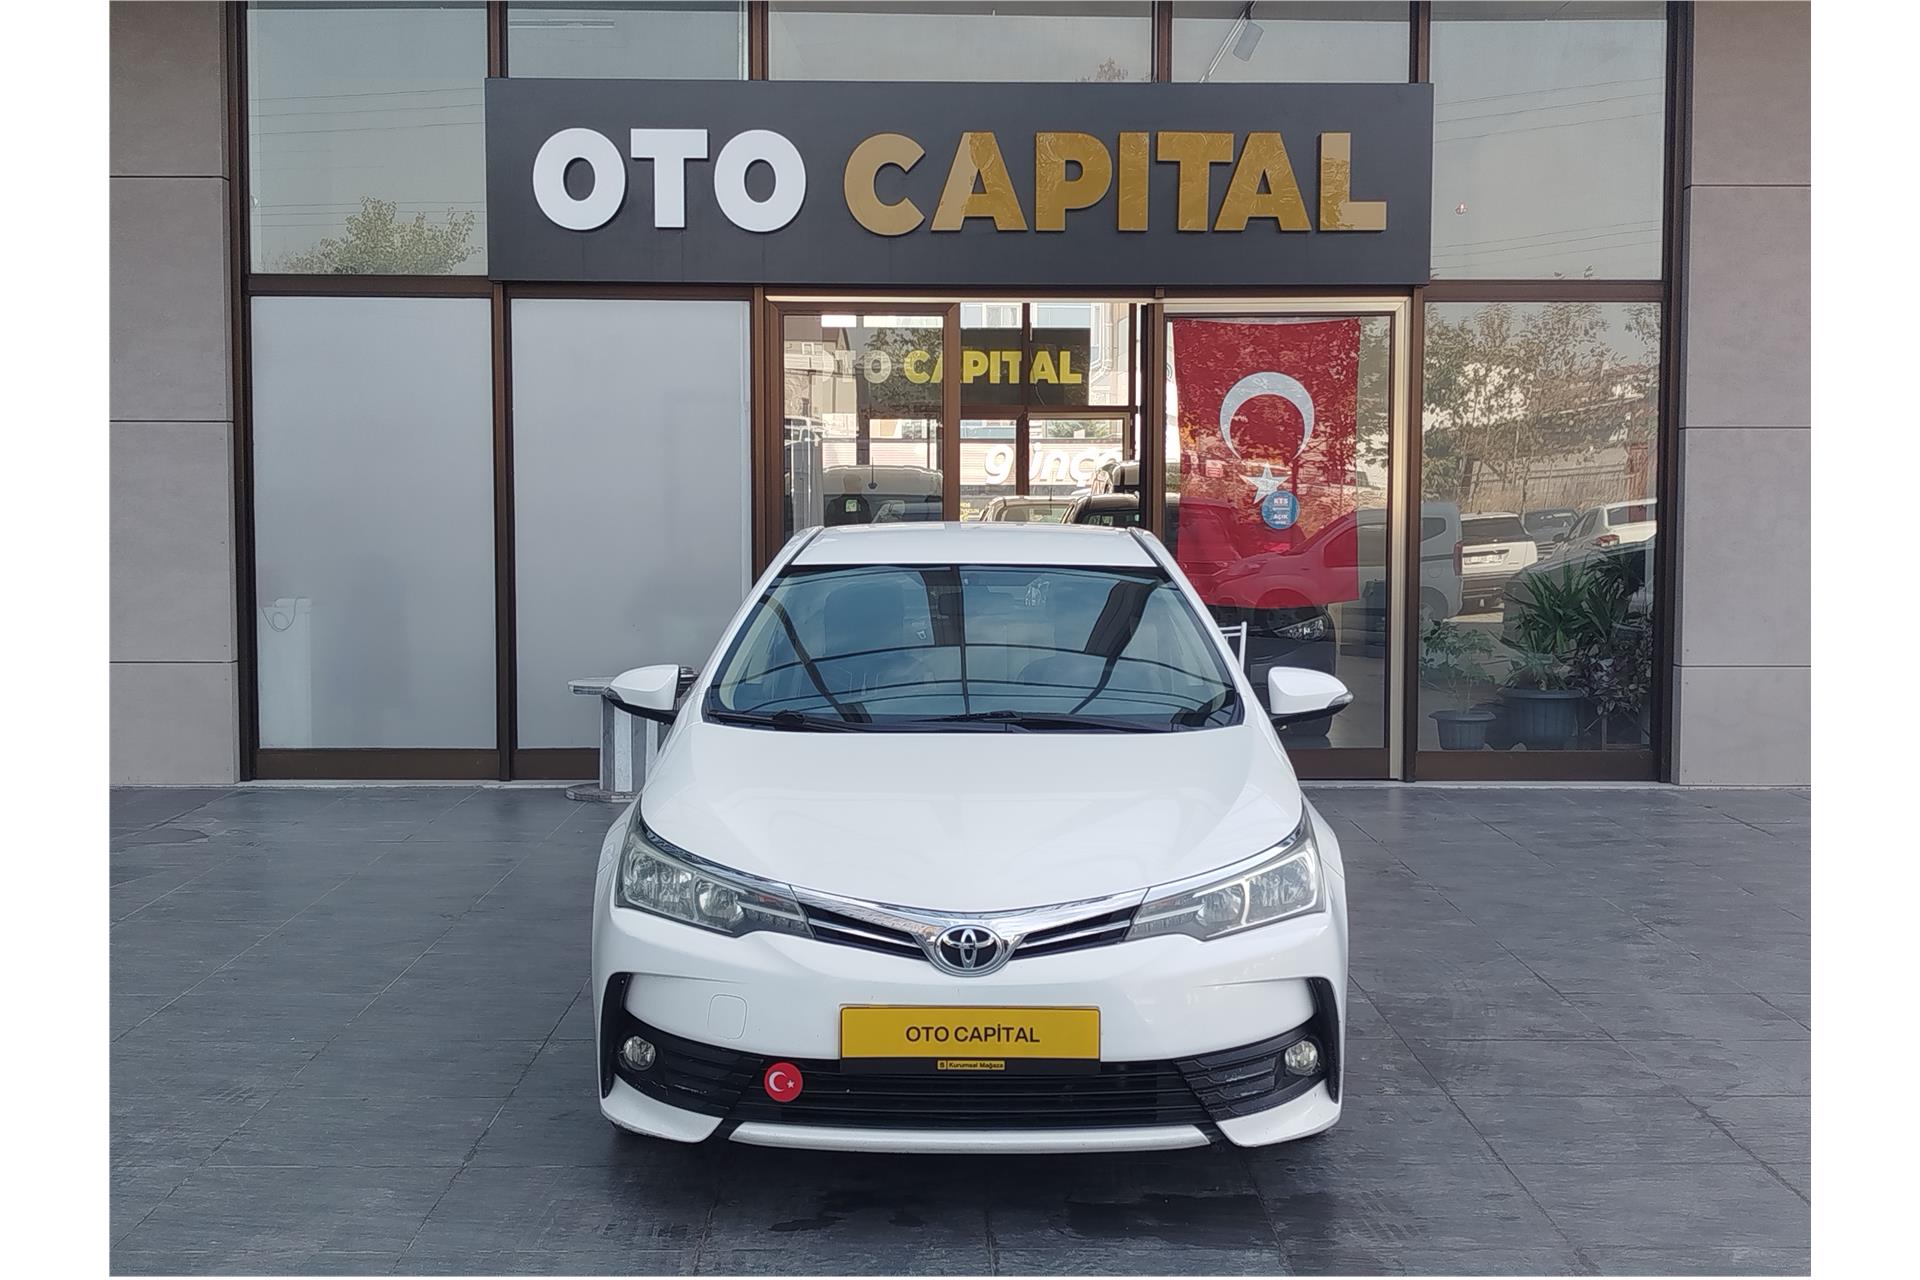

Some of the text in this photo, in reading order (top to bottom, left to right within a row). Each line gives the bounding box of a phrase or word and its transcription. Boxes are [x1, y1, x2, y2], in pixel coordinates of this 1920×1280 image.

[532, 128, 1388, 236] OTO CAPITAL
[905, 1024, 1041, 1043] OTO CAPİTAL
